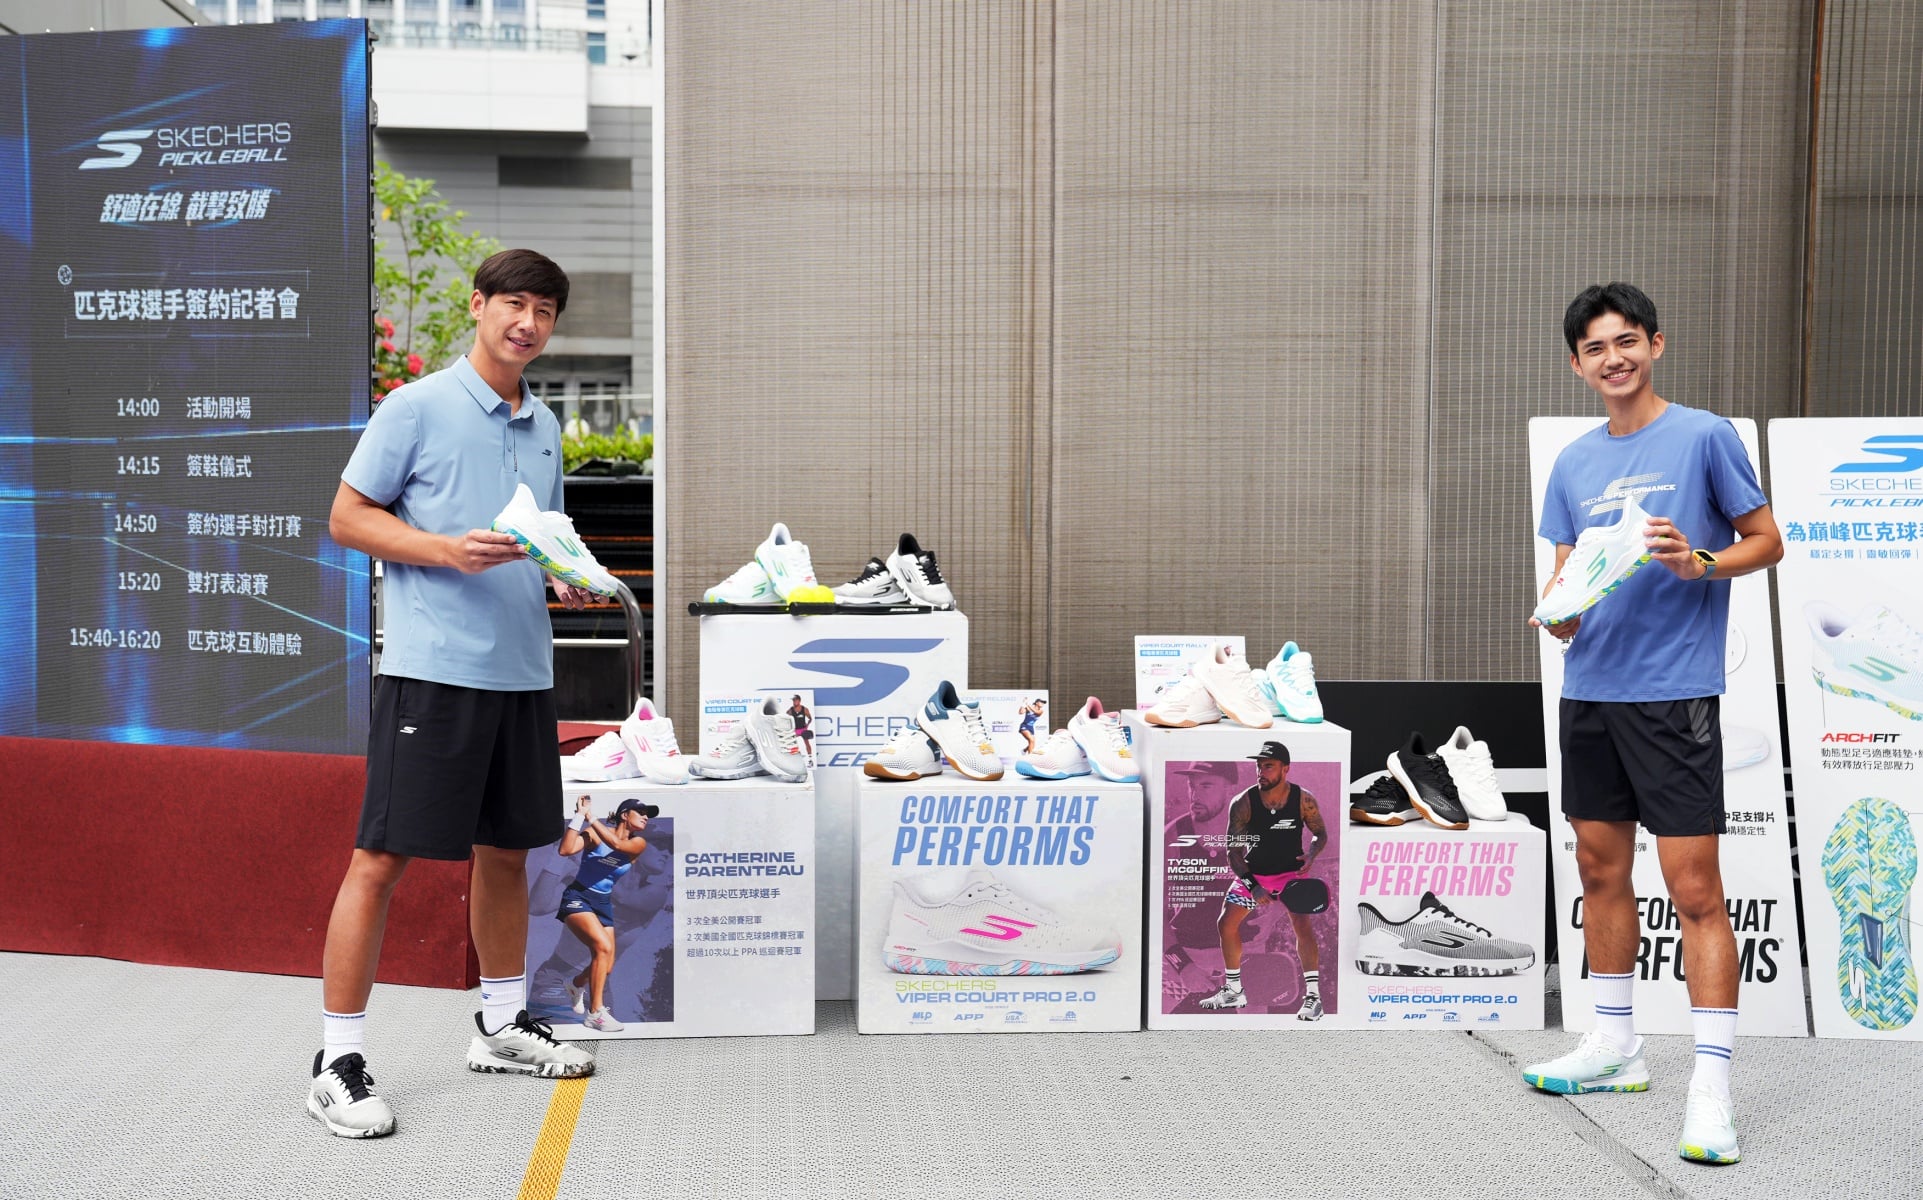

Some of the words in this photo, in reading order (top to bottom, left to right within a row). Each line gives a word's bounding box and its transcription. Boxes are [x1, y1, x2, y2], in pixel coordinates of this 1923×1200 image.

[157, 123, 291, 148] SKECHERS
[158, 148, 287, 166] PICKLEBALL
[100, 191, 183, 223] 舒適在線
[74, 286, 300, 321] 匹克球選手簽約記者會
[117, 398, 160, 418] 14:00
[186, 396, 251, 420] 活動開場
[117, 456, 160, 476] 14:15
[186, 454, 252, 479] 簽鞋儀式
[114, 514, 157, 533] 14:50
[187, 512, 301, 538] 簽約選手對打賽
[1786, 521, 1923, 542] 為巔峰匹克球
[118, 572, 161, 591] 15:20
[187, 571, 269, 596] 雙打表演賽
[70, 627, 161, 650] 15:40-16:20
[188, 629, 302, 656] 匹克球互動體驗
[1820, 733, 1900, 743] ARCHFIT
[900, 795, 1028, 824] COMFORT
[1035, 795, 1099, 824] THAT
[892, 826, 1094, 866] PERFORMS
[1203, 834, 1260, 842] SKECHERS
[685, 852, 795, 864] CATHERINE
[1167, 858, 1207, 866] TYSON
[1366, 842, 1464, 864] COMFORT
[1469, 842, 1518, 864] THAT
[685, 865, 804, 877] PARENTEAU
[1359, 865, 1515, 897] PERFORMS
[685, 888, 781, 900] 世界頂尖匹克球選手
[1727, 898, 1778, 931] HAT
[895, 980, 997, 992] SKECHERS
[1368, 985, 1443, 995] SKECHERS
[896, 992, 951, 1004] VIPER
[954, 992, 1020, 1004] COURT
[1022, 991, 1062, 1003] PRO
[1065, 991, 1096, 1002] 2.0
[1368, 995, 1410, 1004] VIPER
[1411, 995, 1460, 1004] COURT
[1462, 995, 1492, 1004] PRO
[1494, 995, 1518, 1004] 2.0
[954, 1013, 984, 1021] APP
